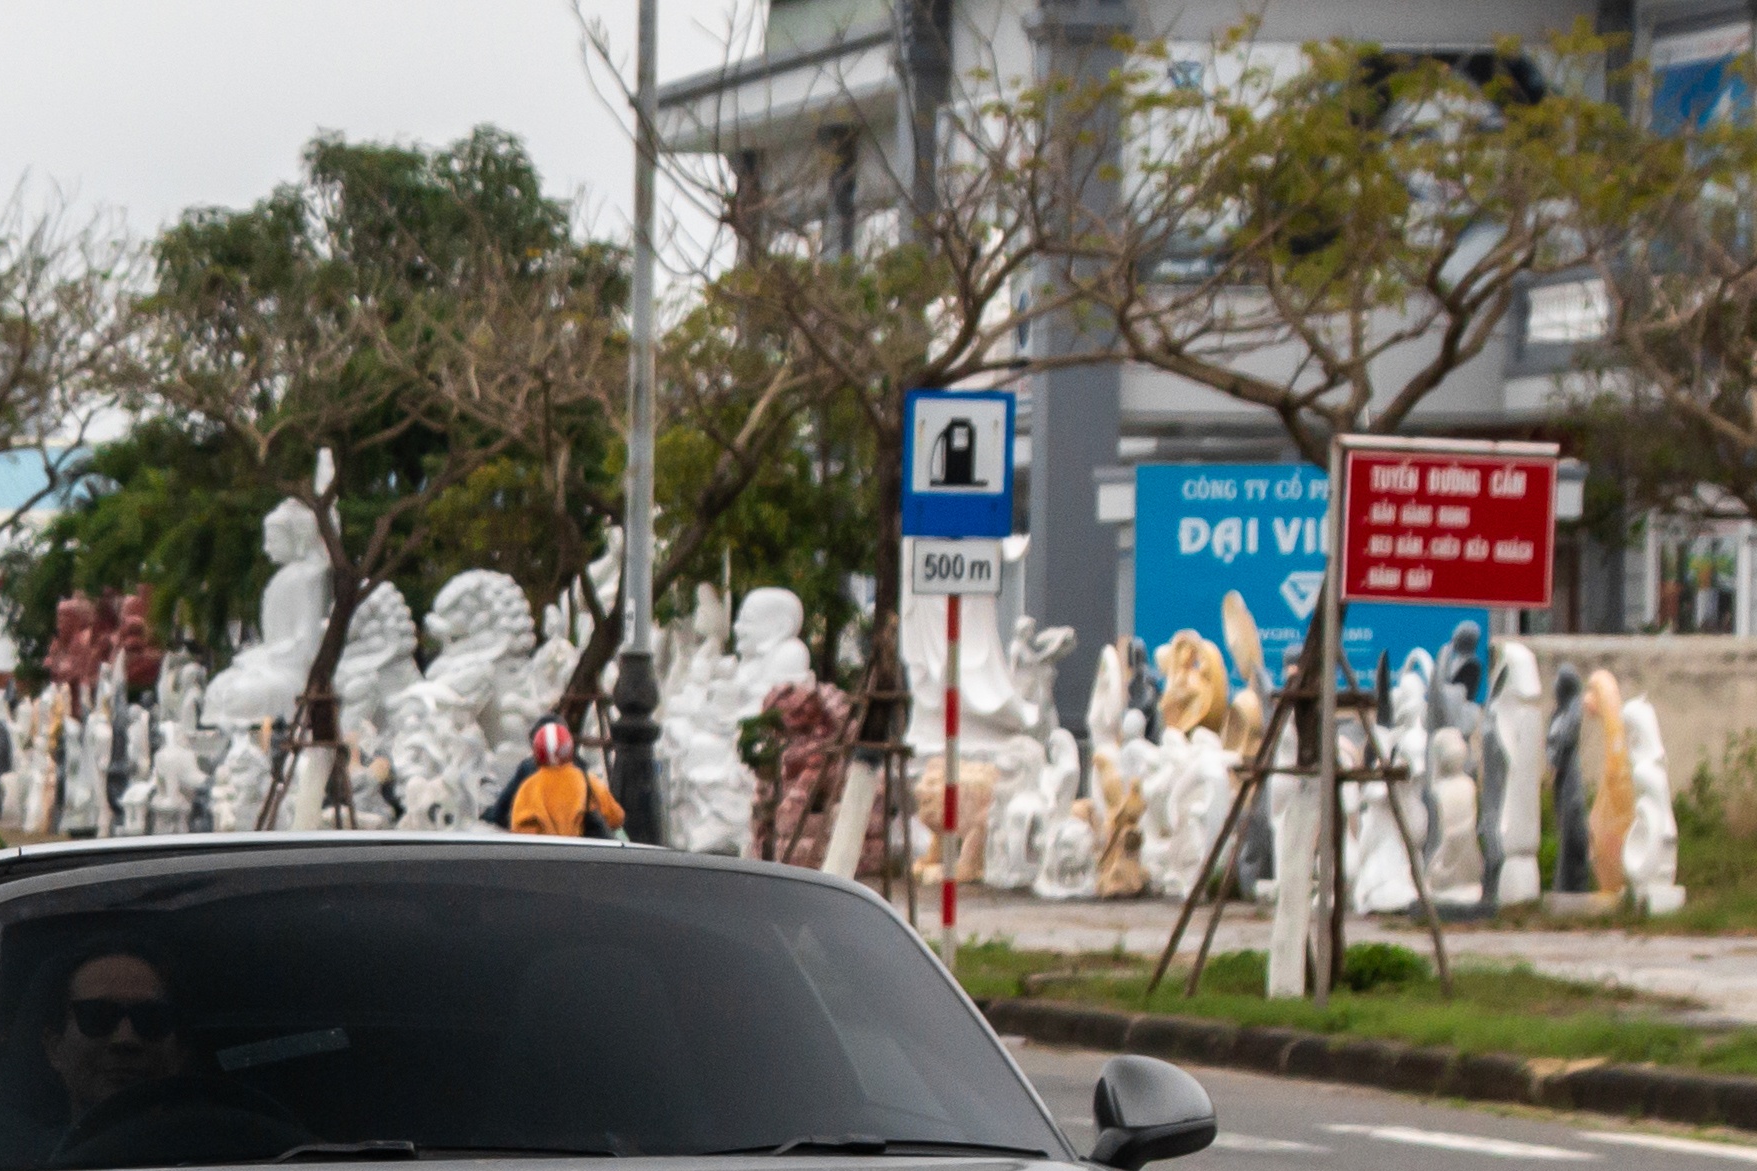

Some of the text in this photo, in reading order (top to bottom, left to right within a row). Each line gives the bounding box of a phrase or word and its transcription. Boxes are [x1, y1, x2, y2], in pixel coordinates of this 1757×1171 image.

[1182, 475, 1238, 500] CÔNG
[1244, 479, 1270, 500] TY
[924, 553, 991, 580] 500 m
